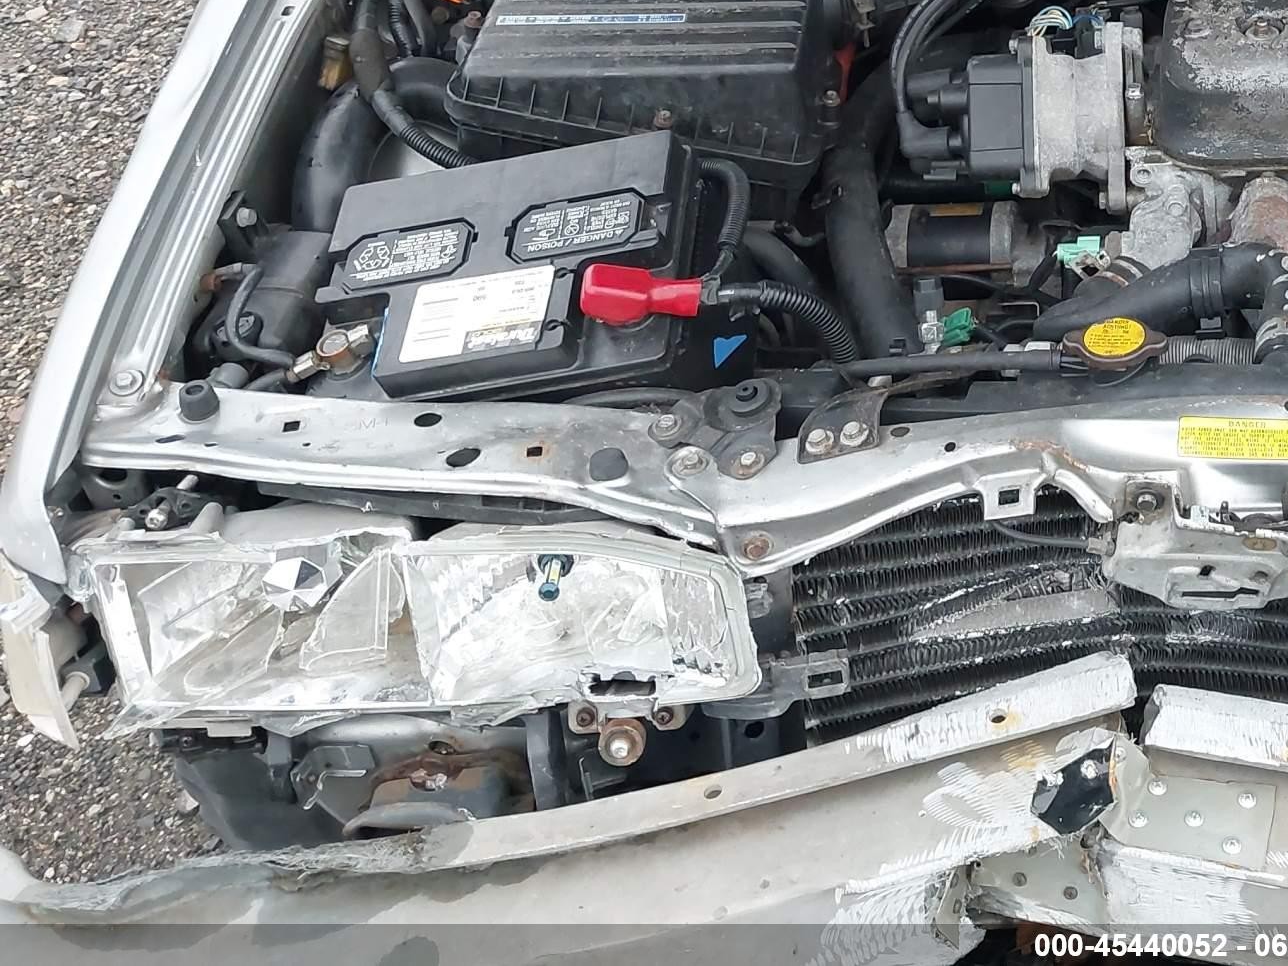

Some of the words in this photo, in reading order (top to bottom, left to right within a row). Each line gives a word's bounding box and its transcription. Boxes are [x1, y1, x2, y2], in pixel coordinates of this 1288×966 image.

[573, 230, 614, 245] DANGER
[527, 239, 564, 253] POISON
[1228, 420, 1267, 429] DANGER
